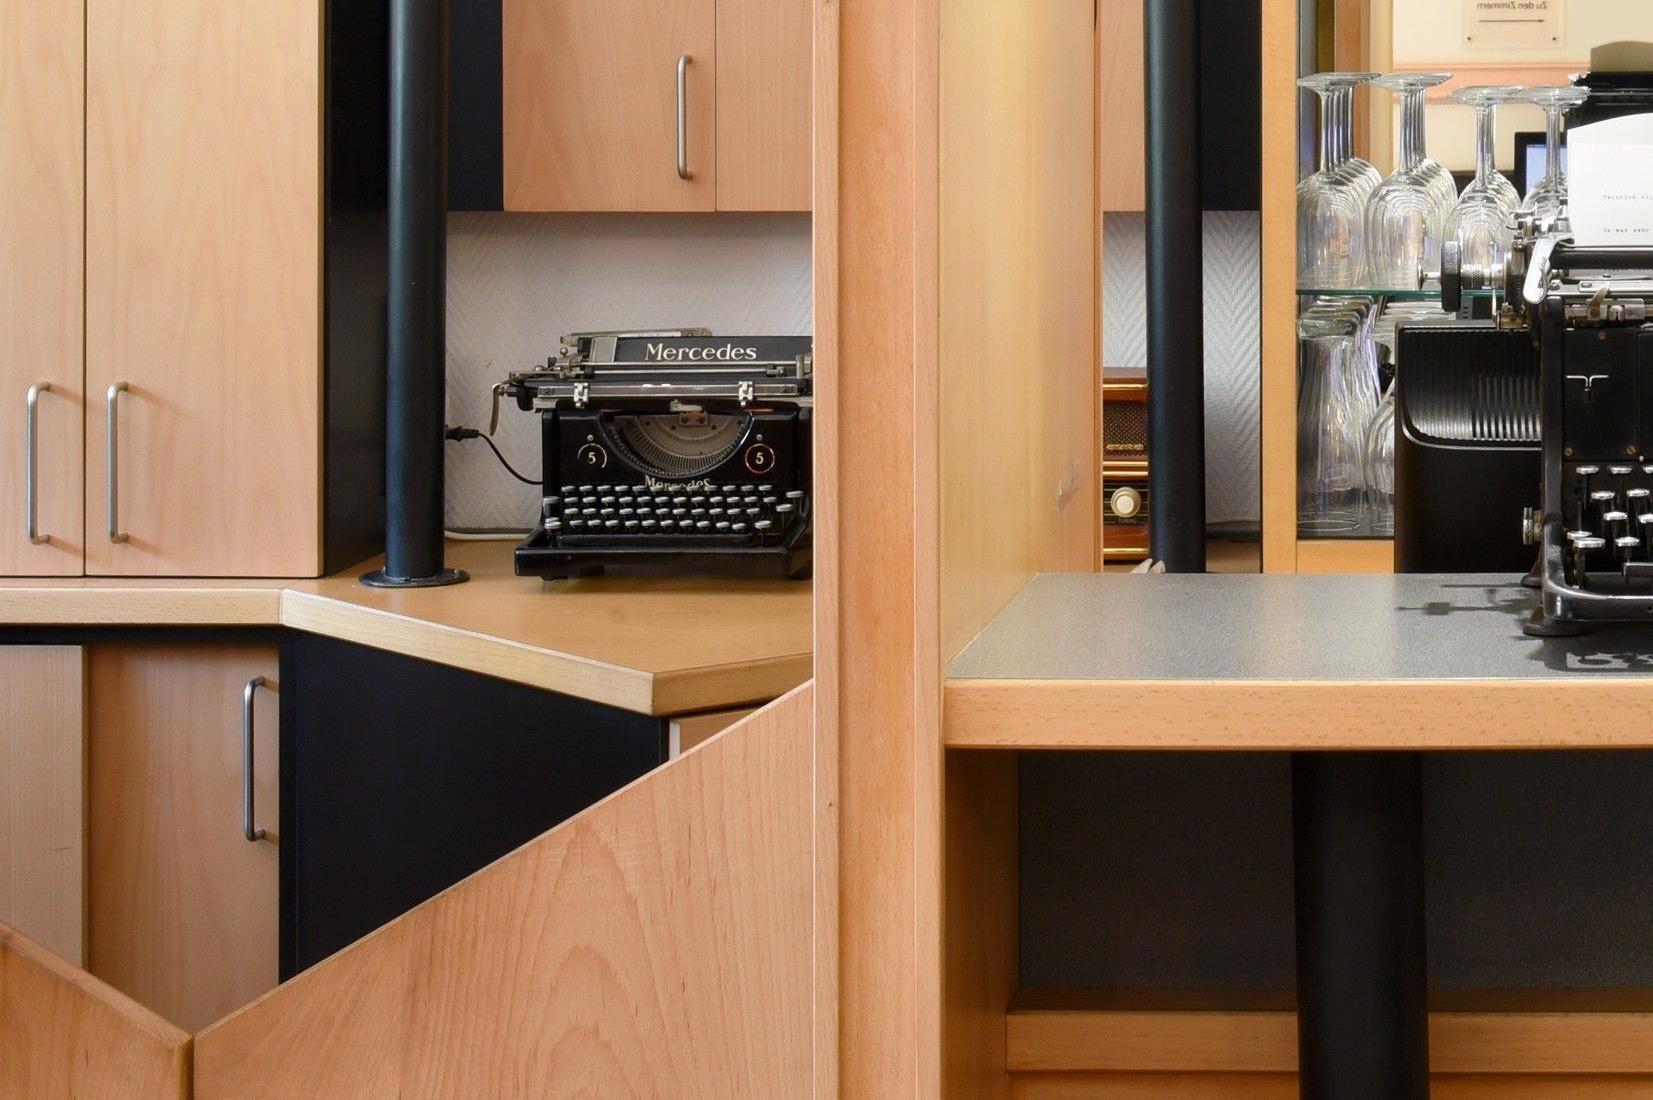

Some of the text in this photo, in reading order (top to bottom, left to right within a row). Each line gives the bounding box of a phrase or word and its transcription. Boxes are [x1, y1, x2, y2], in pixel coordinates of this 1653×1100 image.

[644, 342, 758, 361] Mercedes
[588, 452, 597, 465] 5
[755, 451, 764, 465] 5
